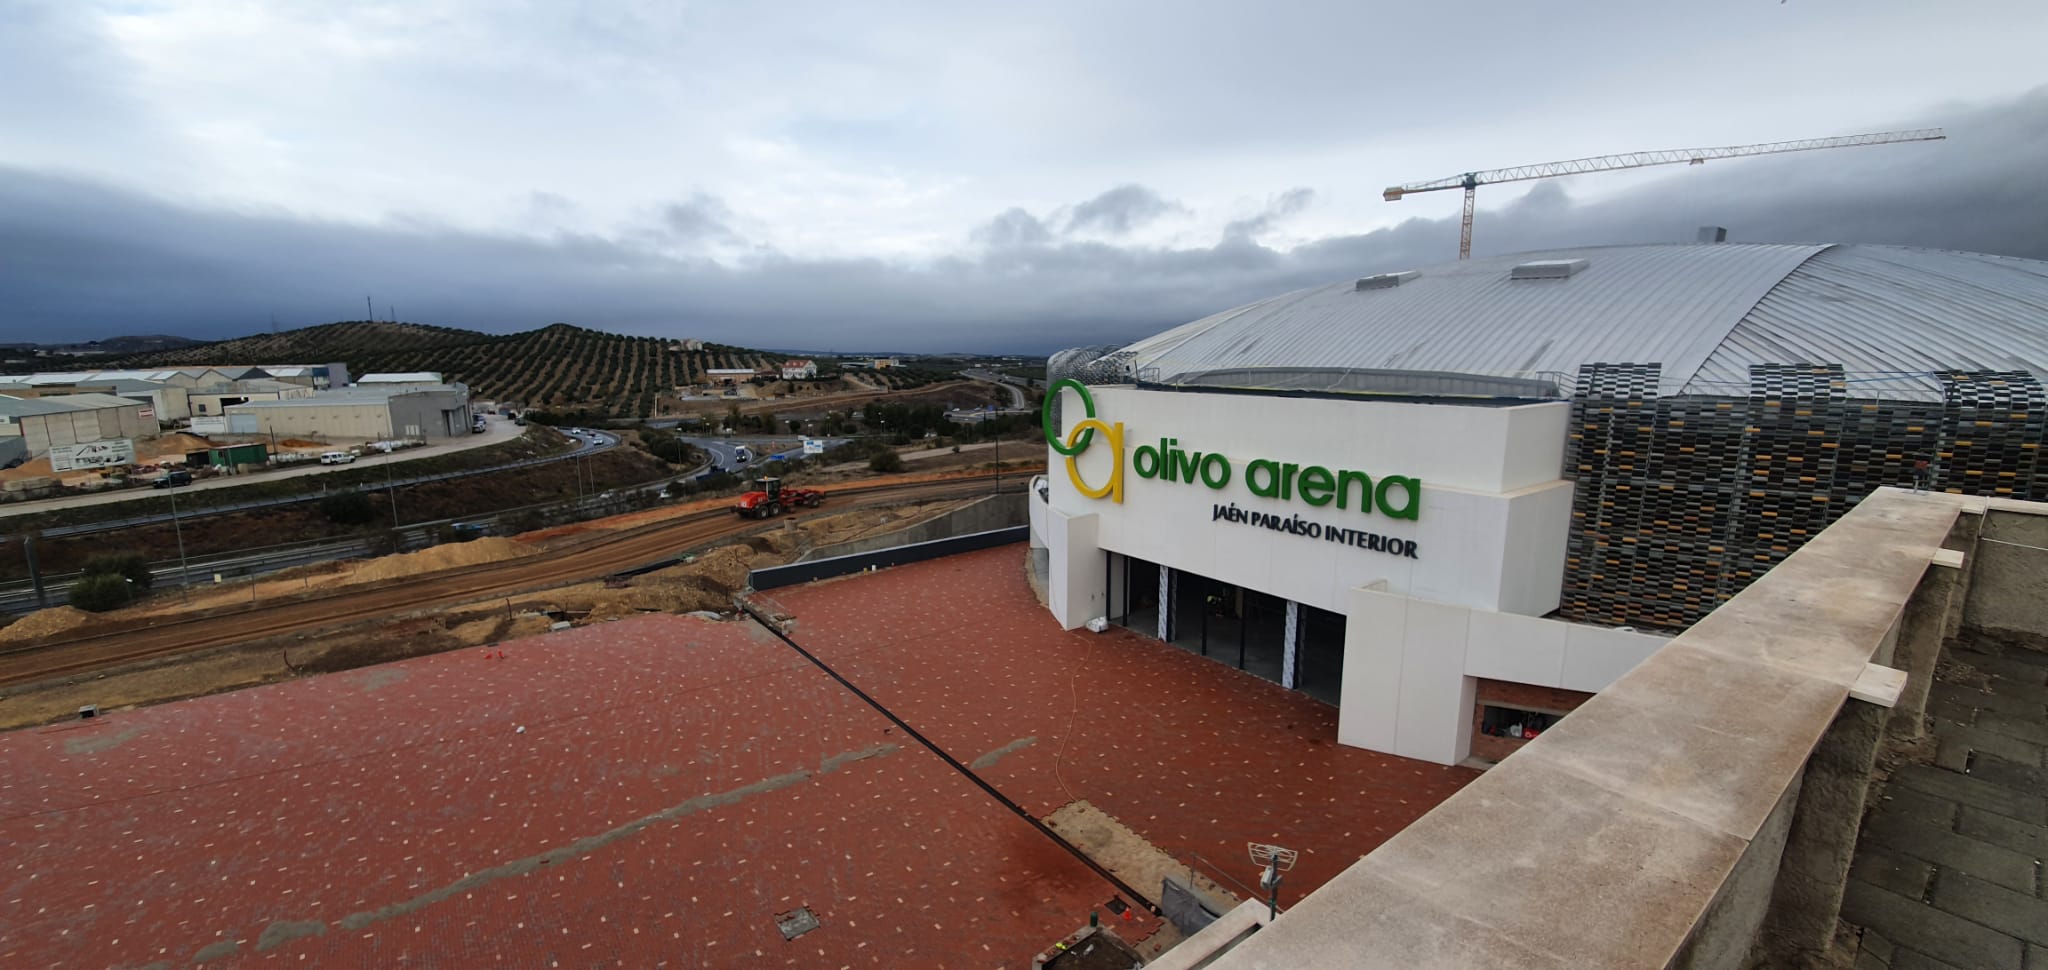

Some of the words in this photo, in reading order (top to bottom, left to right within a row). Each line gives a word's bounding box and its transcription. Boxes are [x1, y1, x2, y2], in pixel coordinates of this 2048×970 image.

[1133, 437, 1232, 490] olivo
[1246, 458, 1422, 521] arena
[1212, 502, 1249, 525] JAÉN
[1250, 513, 1322, 539] PARAÍSO
[1324, 525, 1419, 560] INTERIOR
